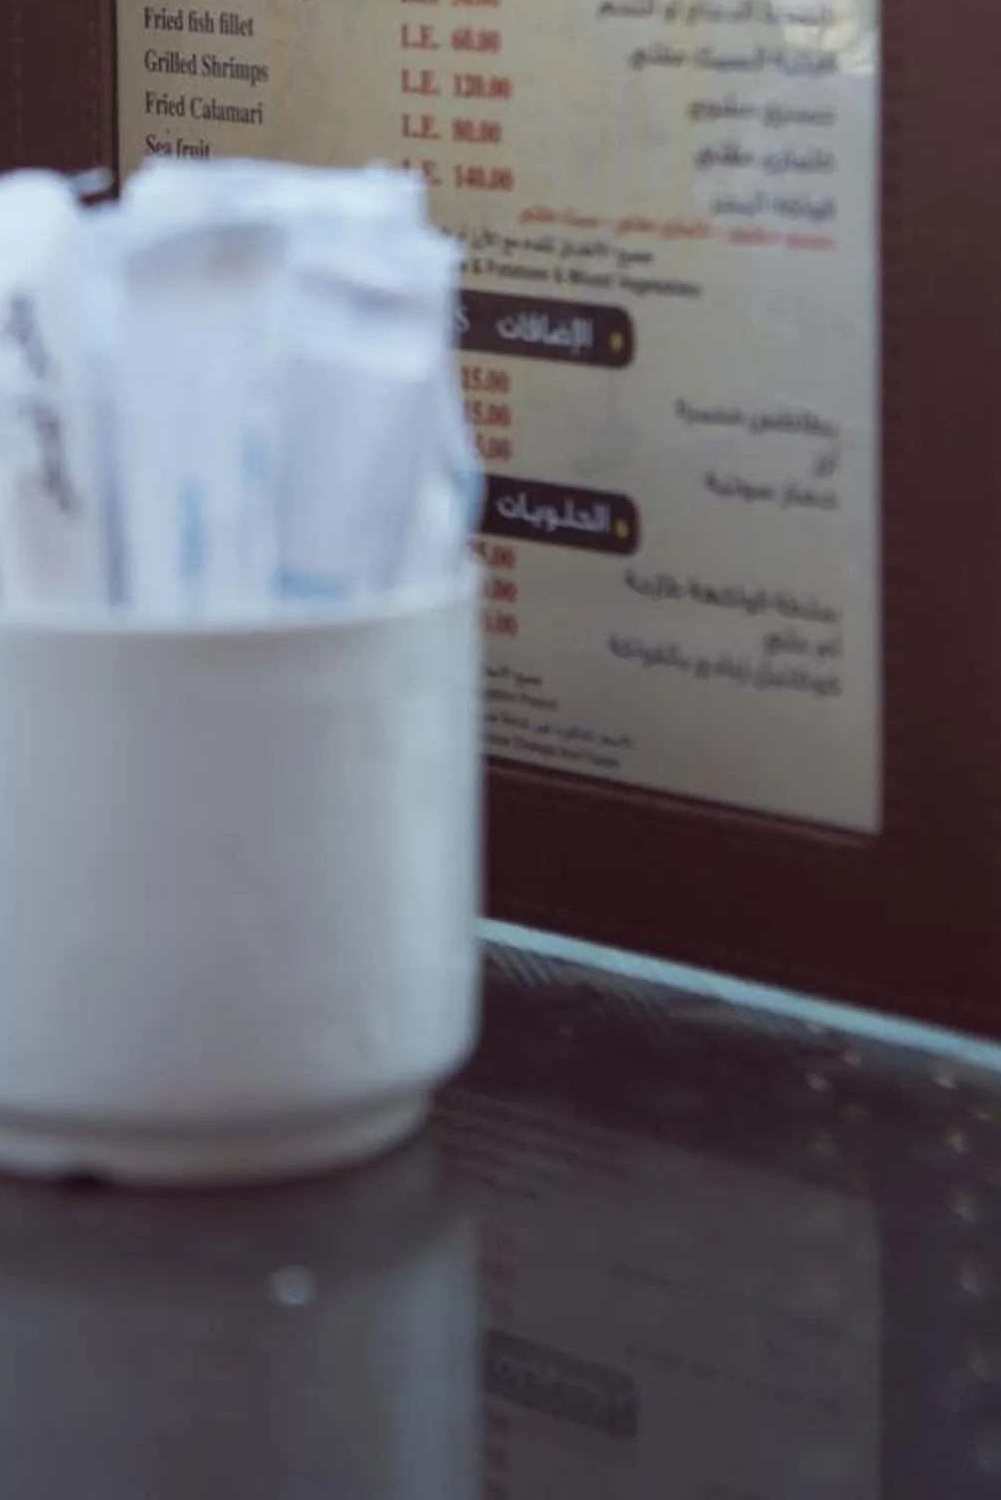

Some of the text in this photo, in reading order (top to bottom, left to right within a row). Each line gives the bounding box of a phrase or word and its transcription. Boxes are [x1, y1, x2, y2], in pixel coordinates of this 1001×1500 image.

[143, 6, 255, 37] Fried fish fillet
[400, 23, 441, 50] L.E.
[144, 48, 269, 88] Grilled Shrimps
[401, 68, 441, 97] L.E.
[144, 91, 264, 125] Fried Calamari
[401, 114, 442, 141] L.E.
[145, 133, 211, 160] Sea fruit
